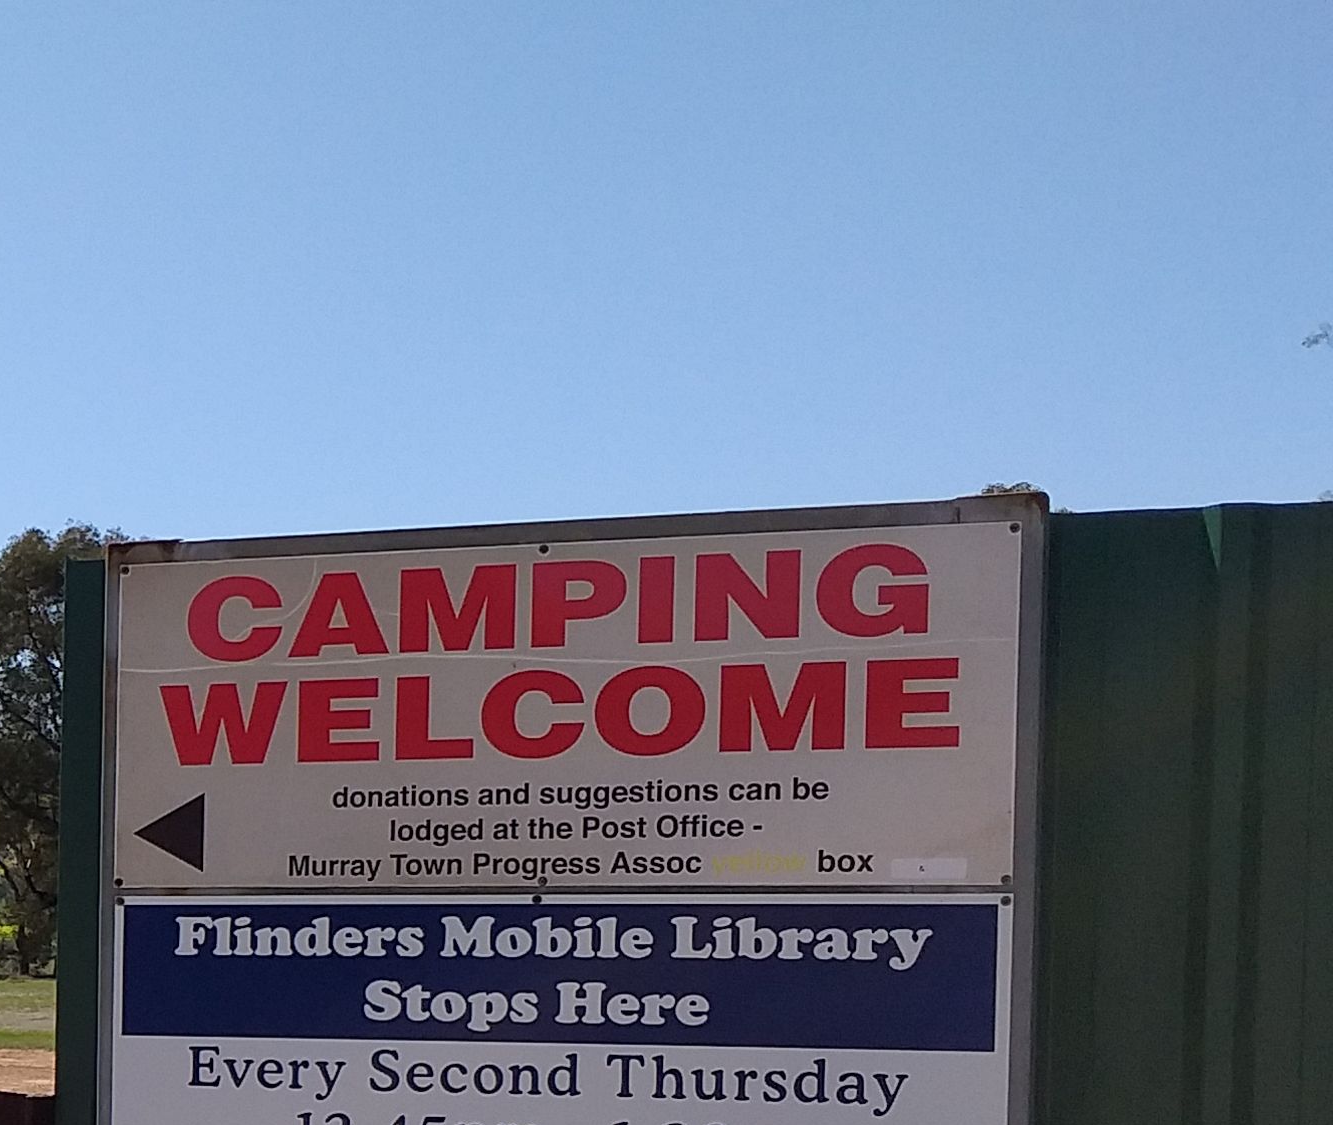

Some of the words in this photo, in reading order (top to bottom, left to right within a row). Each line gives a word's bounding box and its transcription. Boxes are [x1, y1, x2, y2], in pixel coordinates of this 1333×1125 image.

[186, 542, 930, 663] CAMPING
[158, 656, 961, 766] WELCOME
[332, 786, 470, 808] donations
[477, 782, 530, 805] and
[539, 779, 718, 809] suggestions
[728, 782, 781, 801] can
[792, 777, 830, 800] be
[390, 818, 483, 846] lodged
[492, 819, 520, 840] at
[527, 817, 573, 839] the
[582, 816, 647, 839] Post
[655, 814, 744, 838] Office
[287, 854, 382, 882] Murray
[389, 854, 463, 876] Town
[472, 852, 601, 880] Progress
[610, 851, 702, 874] Assoc
[817, 850, 874, 873] box
[174, 916, 424, 957] Flinders
[440, 915, 654, 959] Mobile
[670, 915, 933, 971] Library
[363, 980, 539, 1032] Stops
[553, 981, 711, 1027] Here
[187, 1045, 347, 1101] Every
[368, 1048, 582, 1098] Second
[606, 1053, 909, 1117] Thursday
